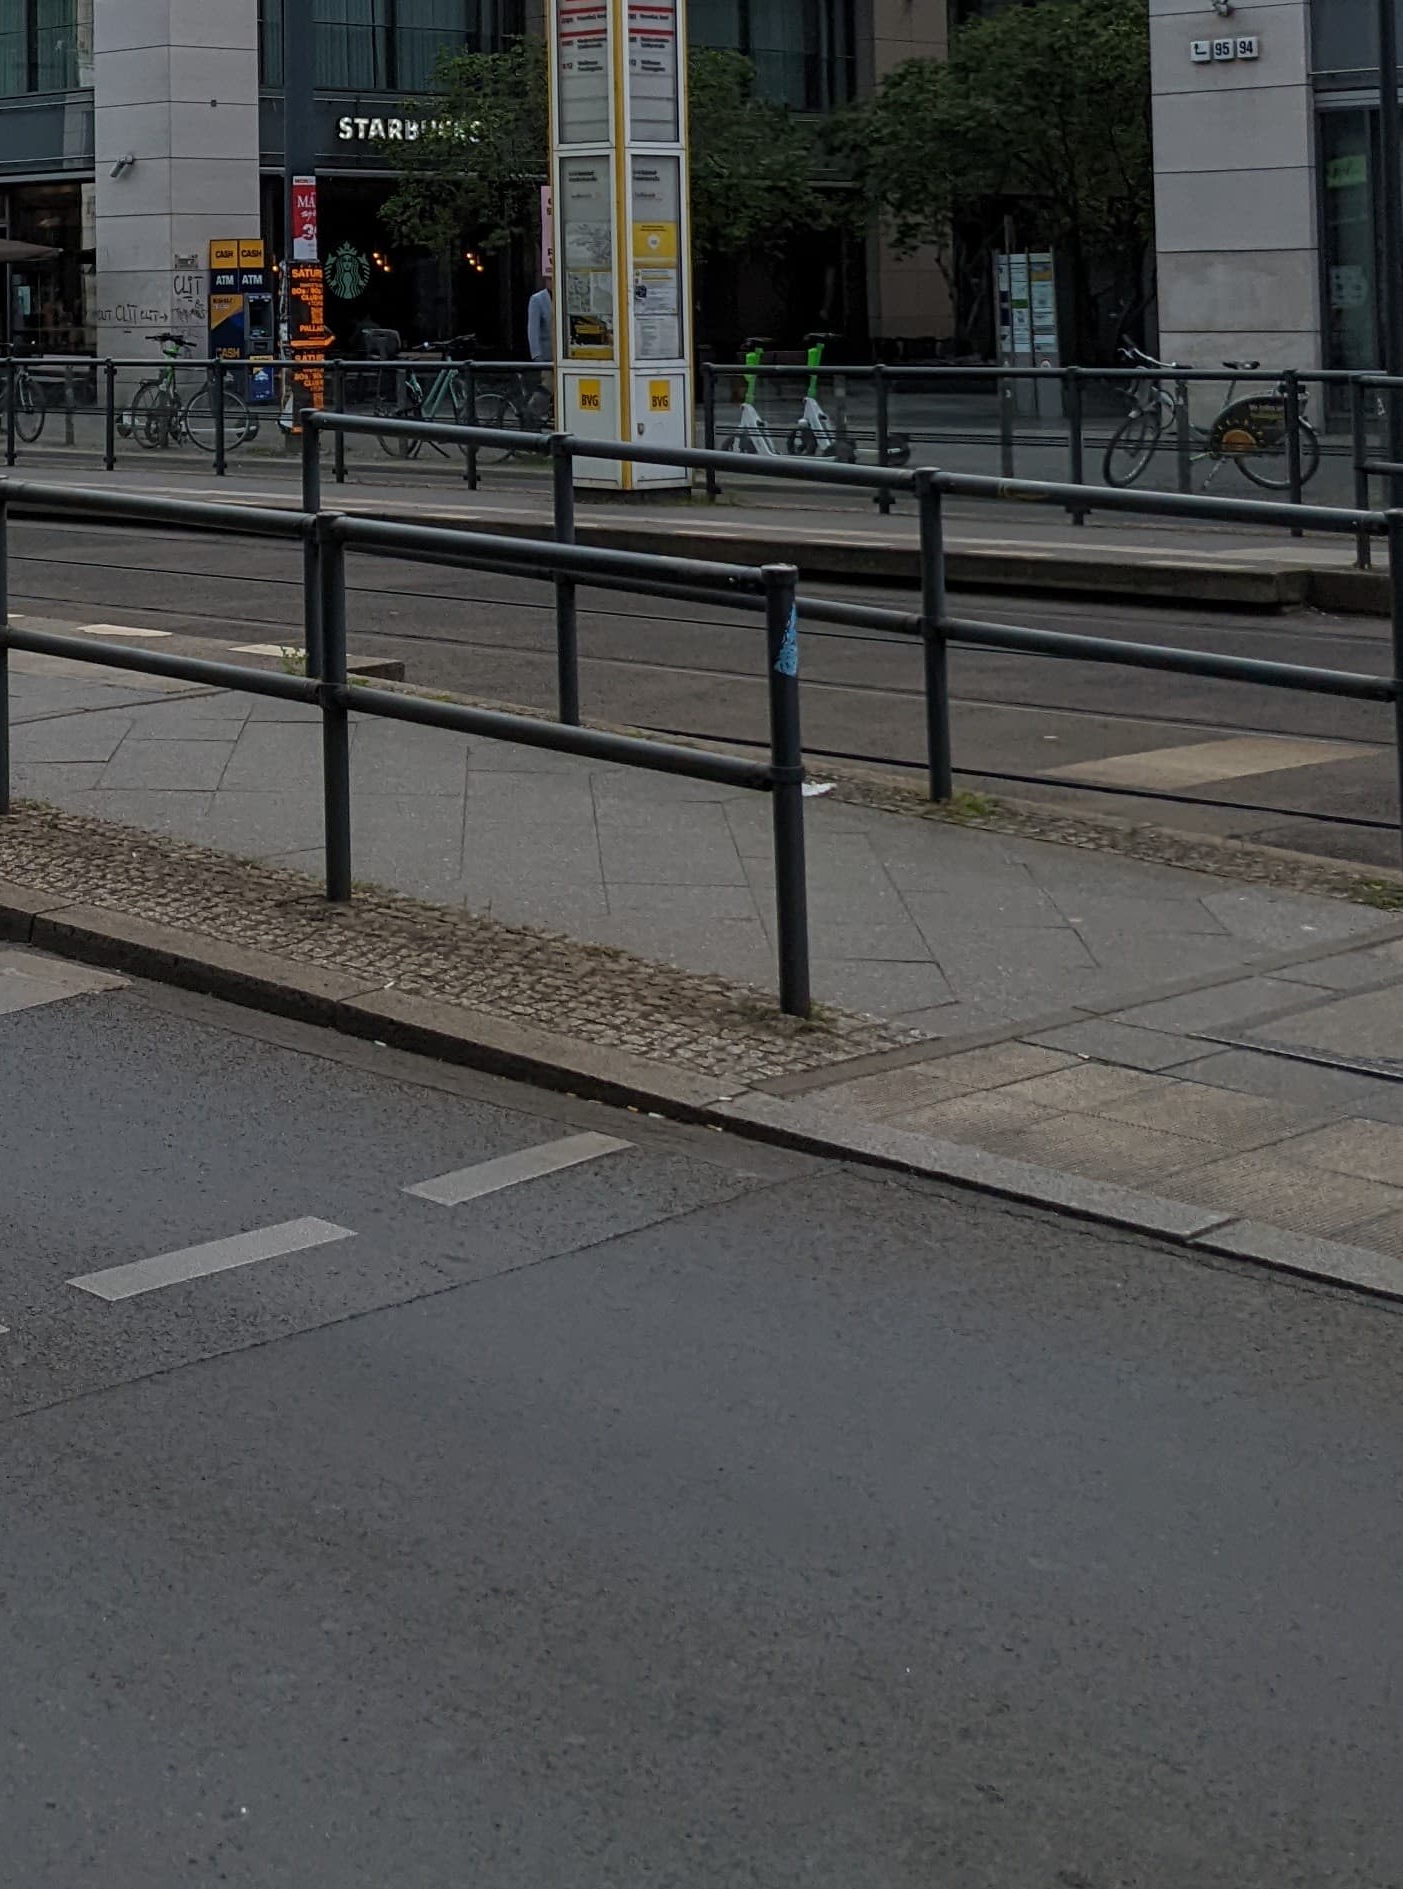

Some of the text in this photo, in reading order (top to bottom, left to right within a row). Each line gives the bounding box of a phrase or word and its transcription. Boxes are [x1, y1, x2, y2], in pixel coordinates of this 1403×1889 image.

[1215, 42, 1229, 56] 95
[1239, 40, 1253, 54] 94
[338, 116, 481, 143] STARBS
[241, 249, 262, 258] CASH
[216, 275, 234, 285] ATM
[242, 275, 263, 285] ATM
[582, 395, 598, 406] BVG
[652, 396, 668, 407] BVG
